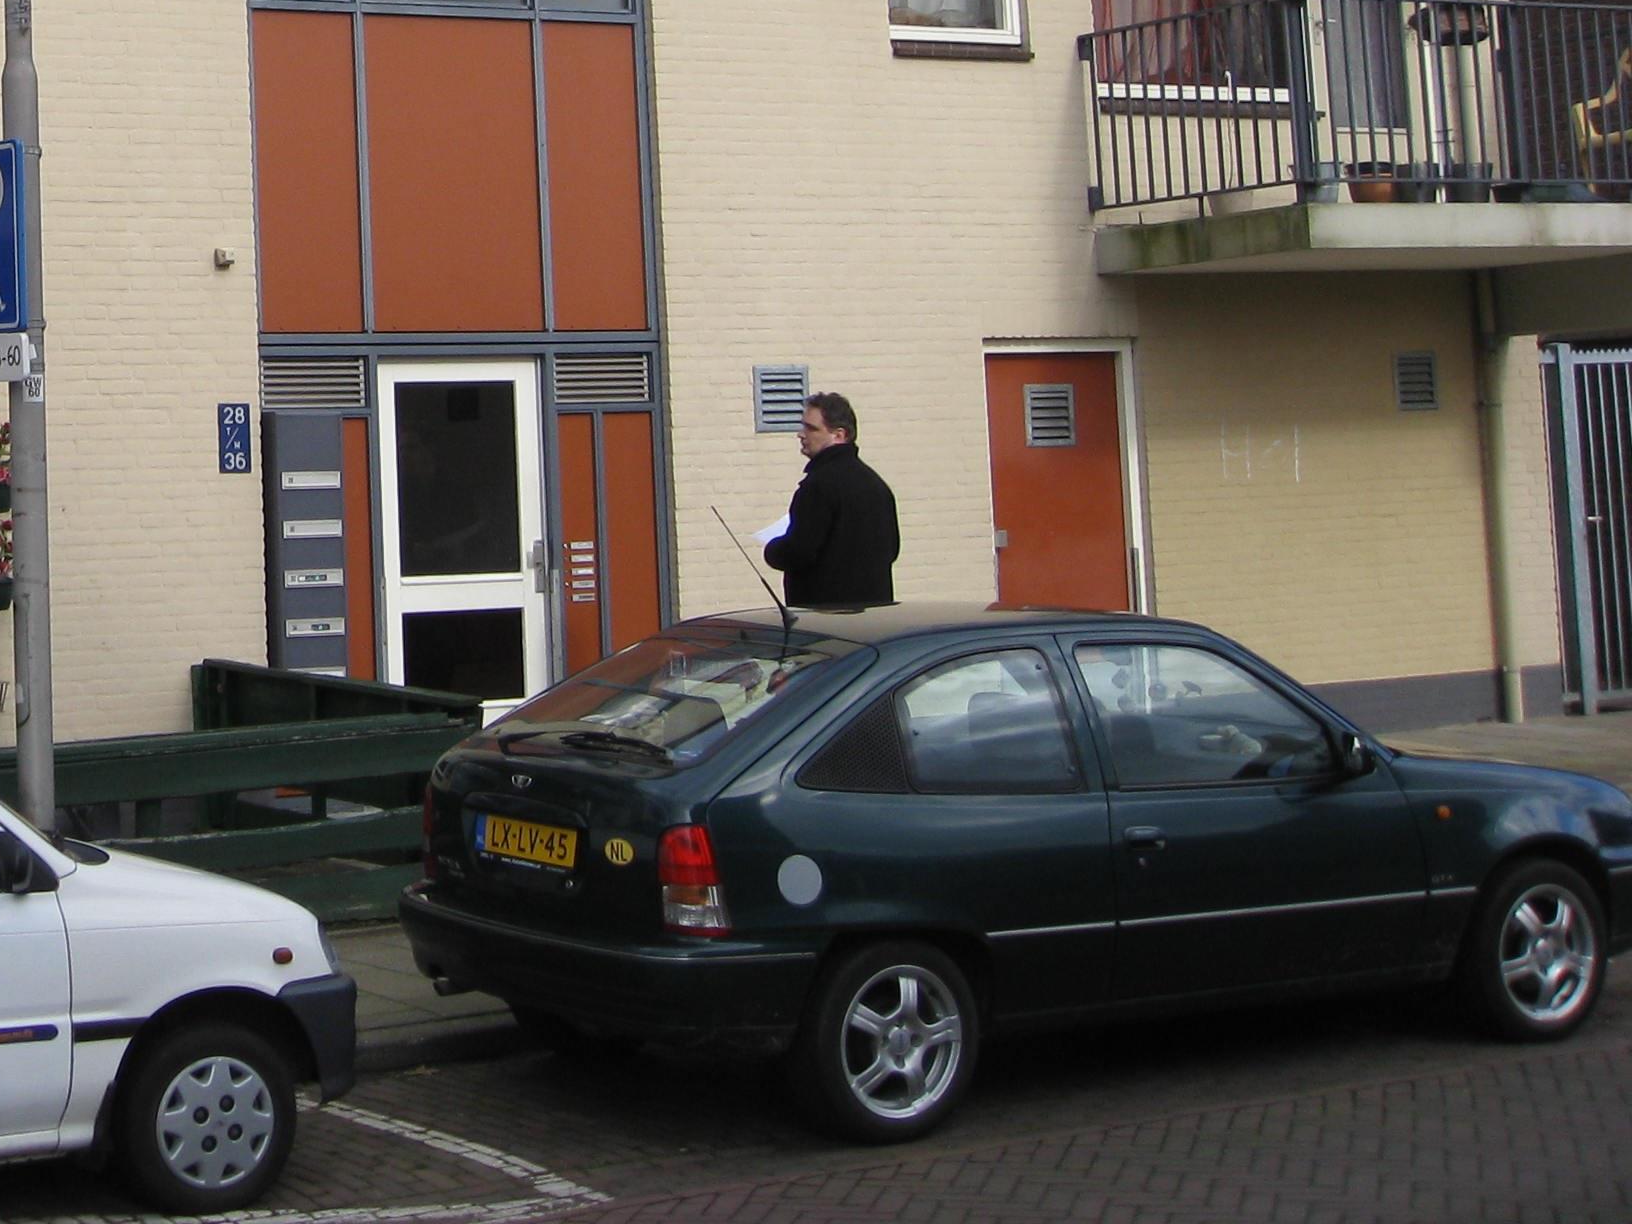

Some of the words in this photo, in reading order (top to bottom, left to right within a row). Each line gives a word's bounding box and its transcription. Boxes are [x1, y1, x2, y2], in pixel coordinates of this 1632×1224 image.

[28, 387, 41, 397] 60
[223, 406, 245, 424] 28
[224, 452, 246, 470] 36
[491, 820, 568, 861] LX-LV-45
[610, 841, 628, 862] NL
